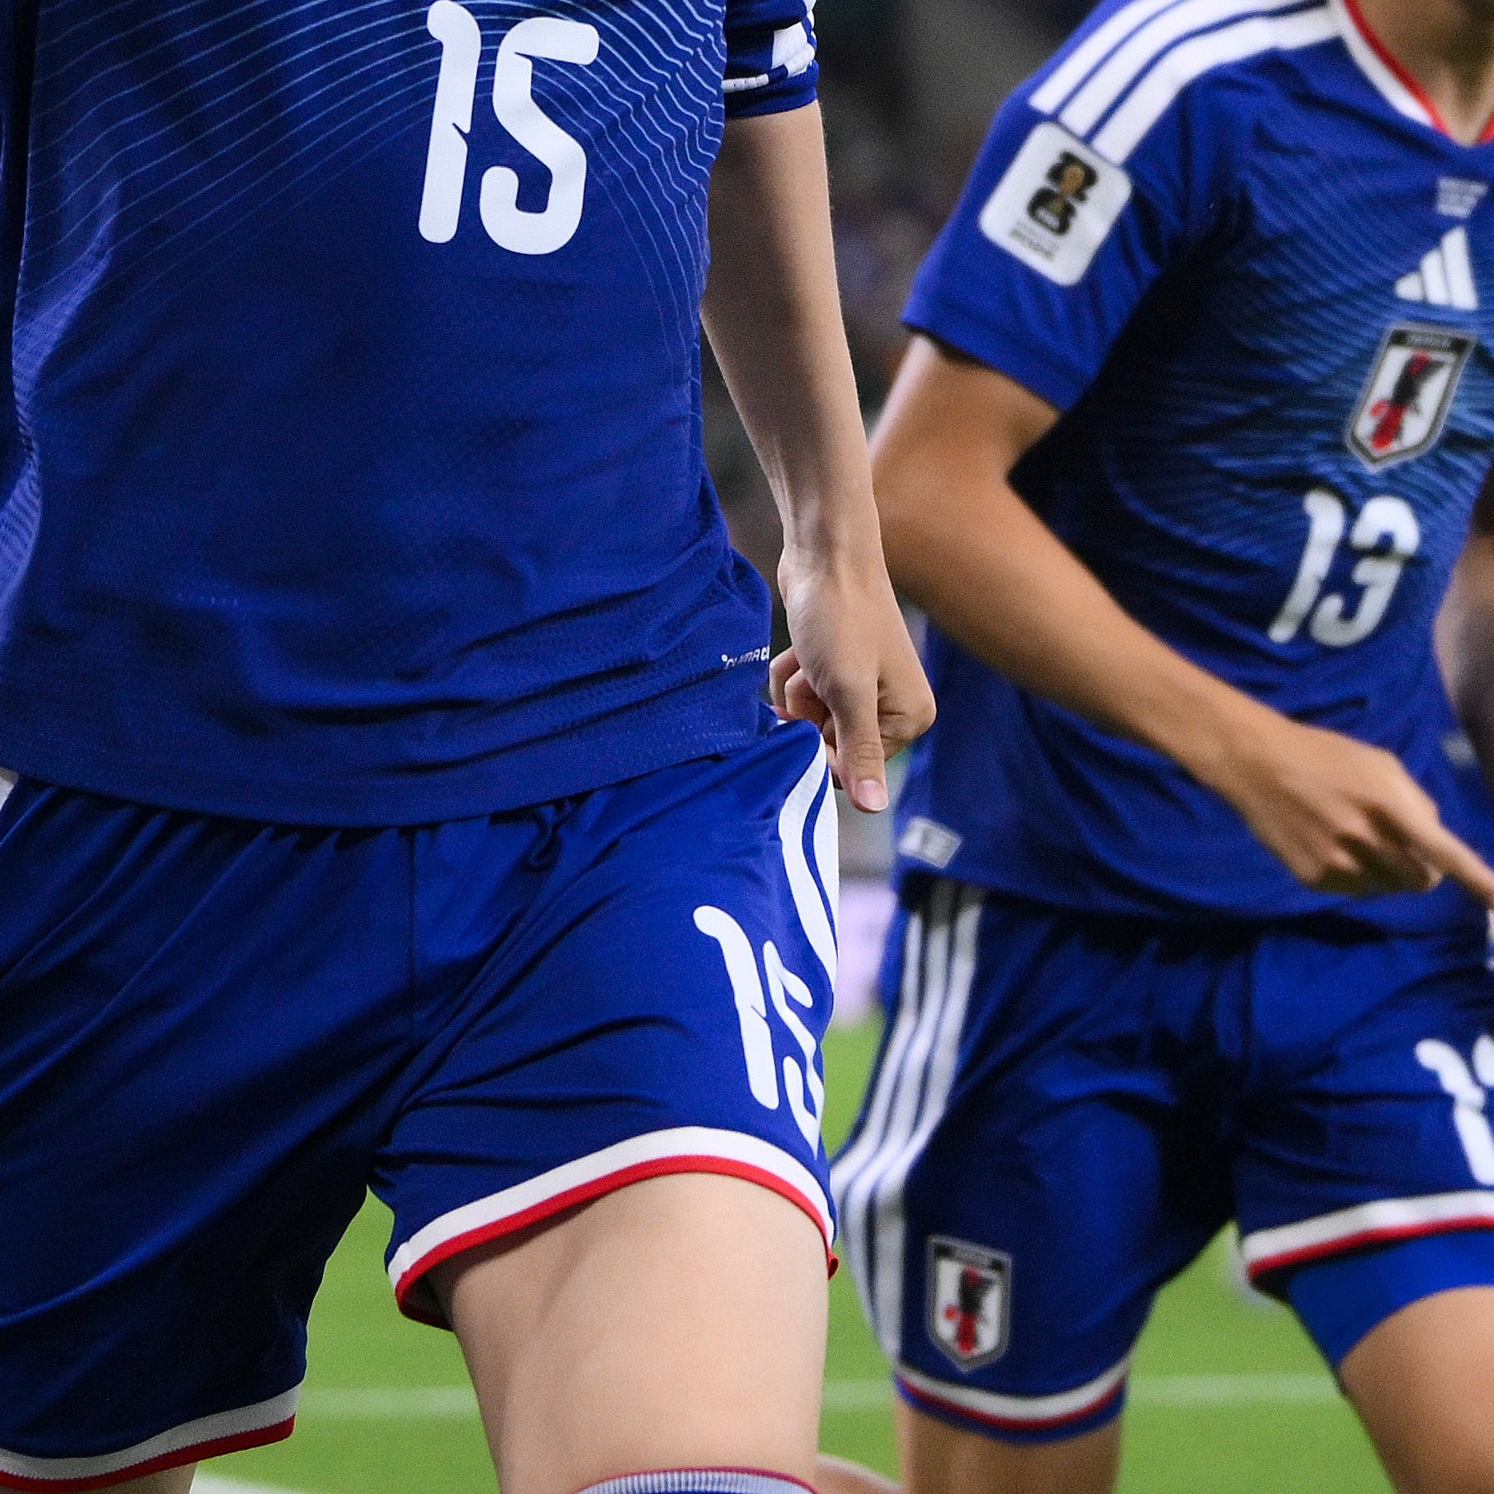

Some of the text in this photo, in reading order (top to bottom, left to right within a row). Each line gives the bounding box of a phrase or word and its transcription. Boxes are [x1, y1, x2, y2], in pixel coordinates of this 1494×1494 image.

[418, 0, 600, 255] 15
[1267, 487, 1421, 648] 13
[692, 905, 825, 1161] 15
